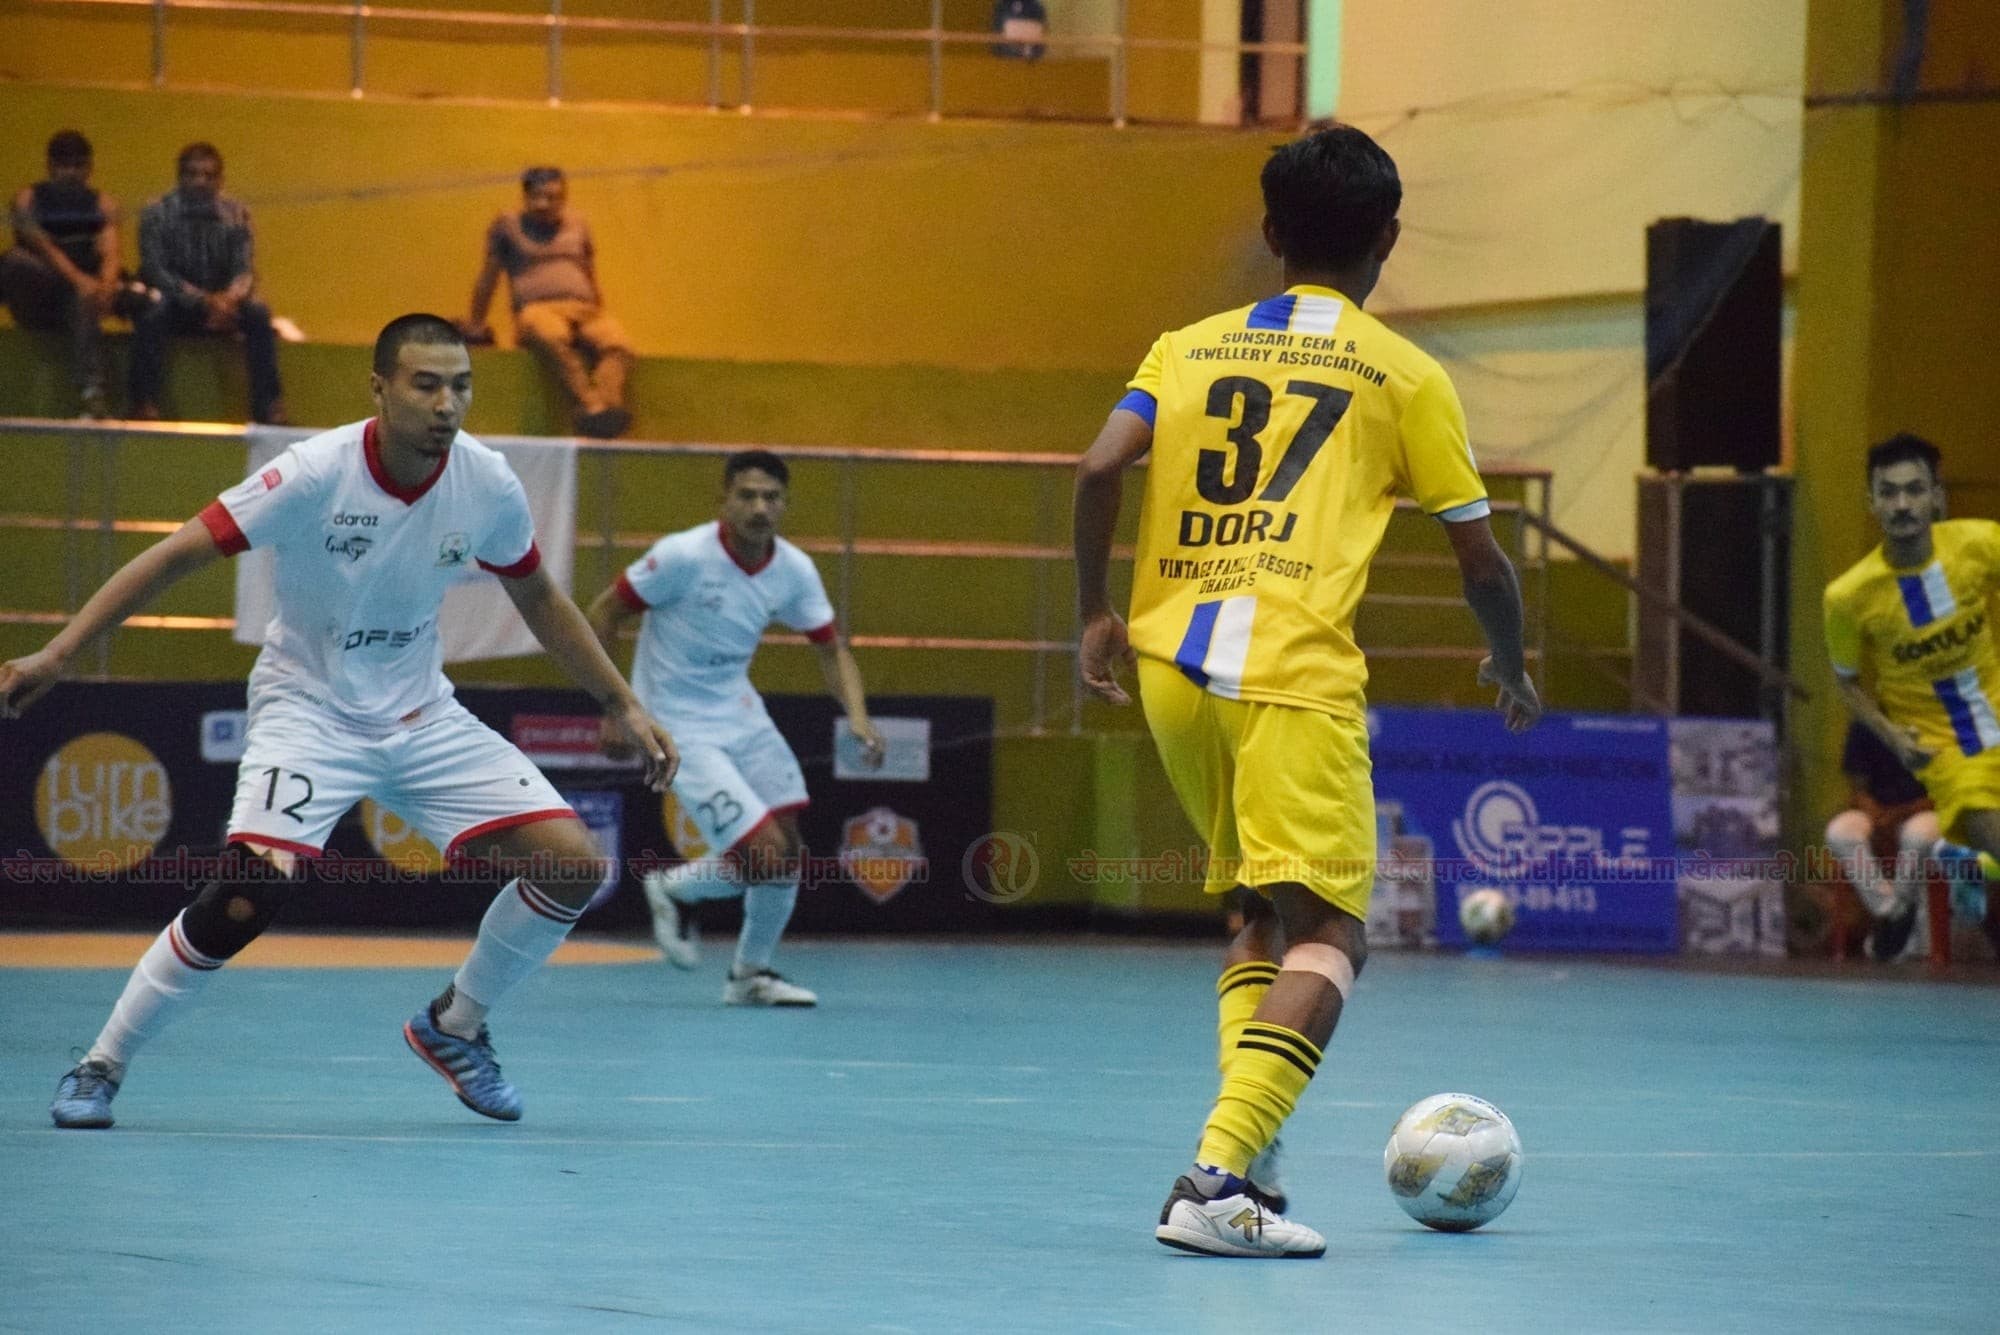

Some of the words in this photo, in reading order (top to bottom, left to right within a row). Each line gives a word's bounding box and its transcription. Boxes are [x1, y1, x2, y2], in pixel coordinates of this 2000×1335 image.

[1221, 332, 1294, 347] SUNSARI
[1302, 336, 1337, 350] GEM
[1344, 340, 1357, 354] &
[1185, 348, 1272, 362] JEWELLERY
[1277, 351, 1388, 387] ASSOCIATION
[1195, 375, 1354, 505] 37
[333, 511, 379, 527] daraz
[1178, 509, 1299, 547] DORJ
[1159, 558, 1213, 580] VINTAGE
[1256, 552, 1314, 581] RESORT
[261, 766, 314, 823] 12
[695, 789, 744, 836] 23
